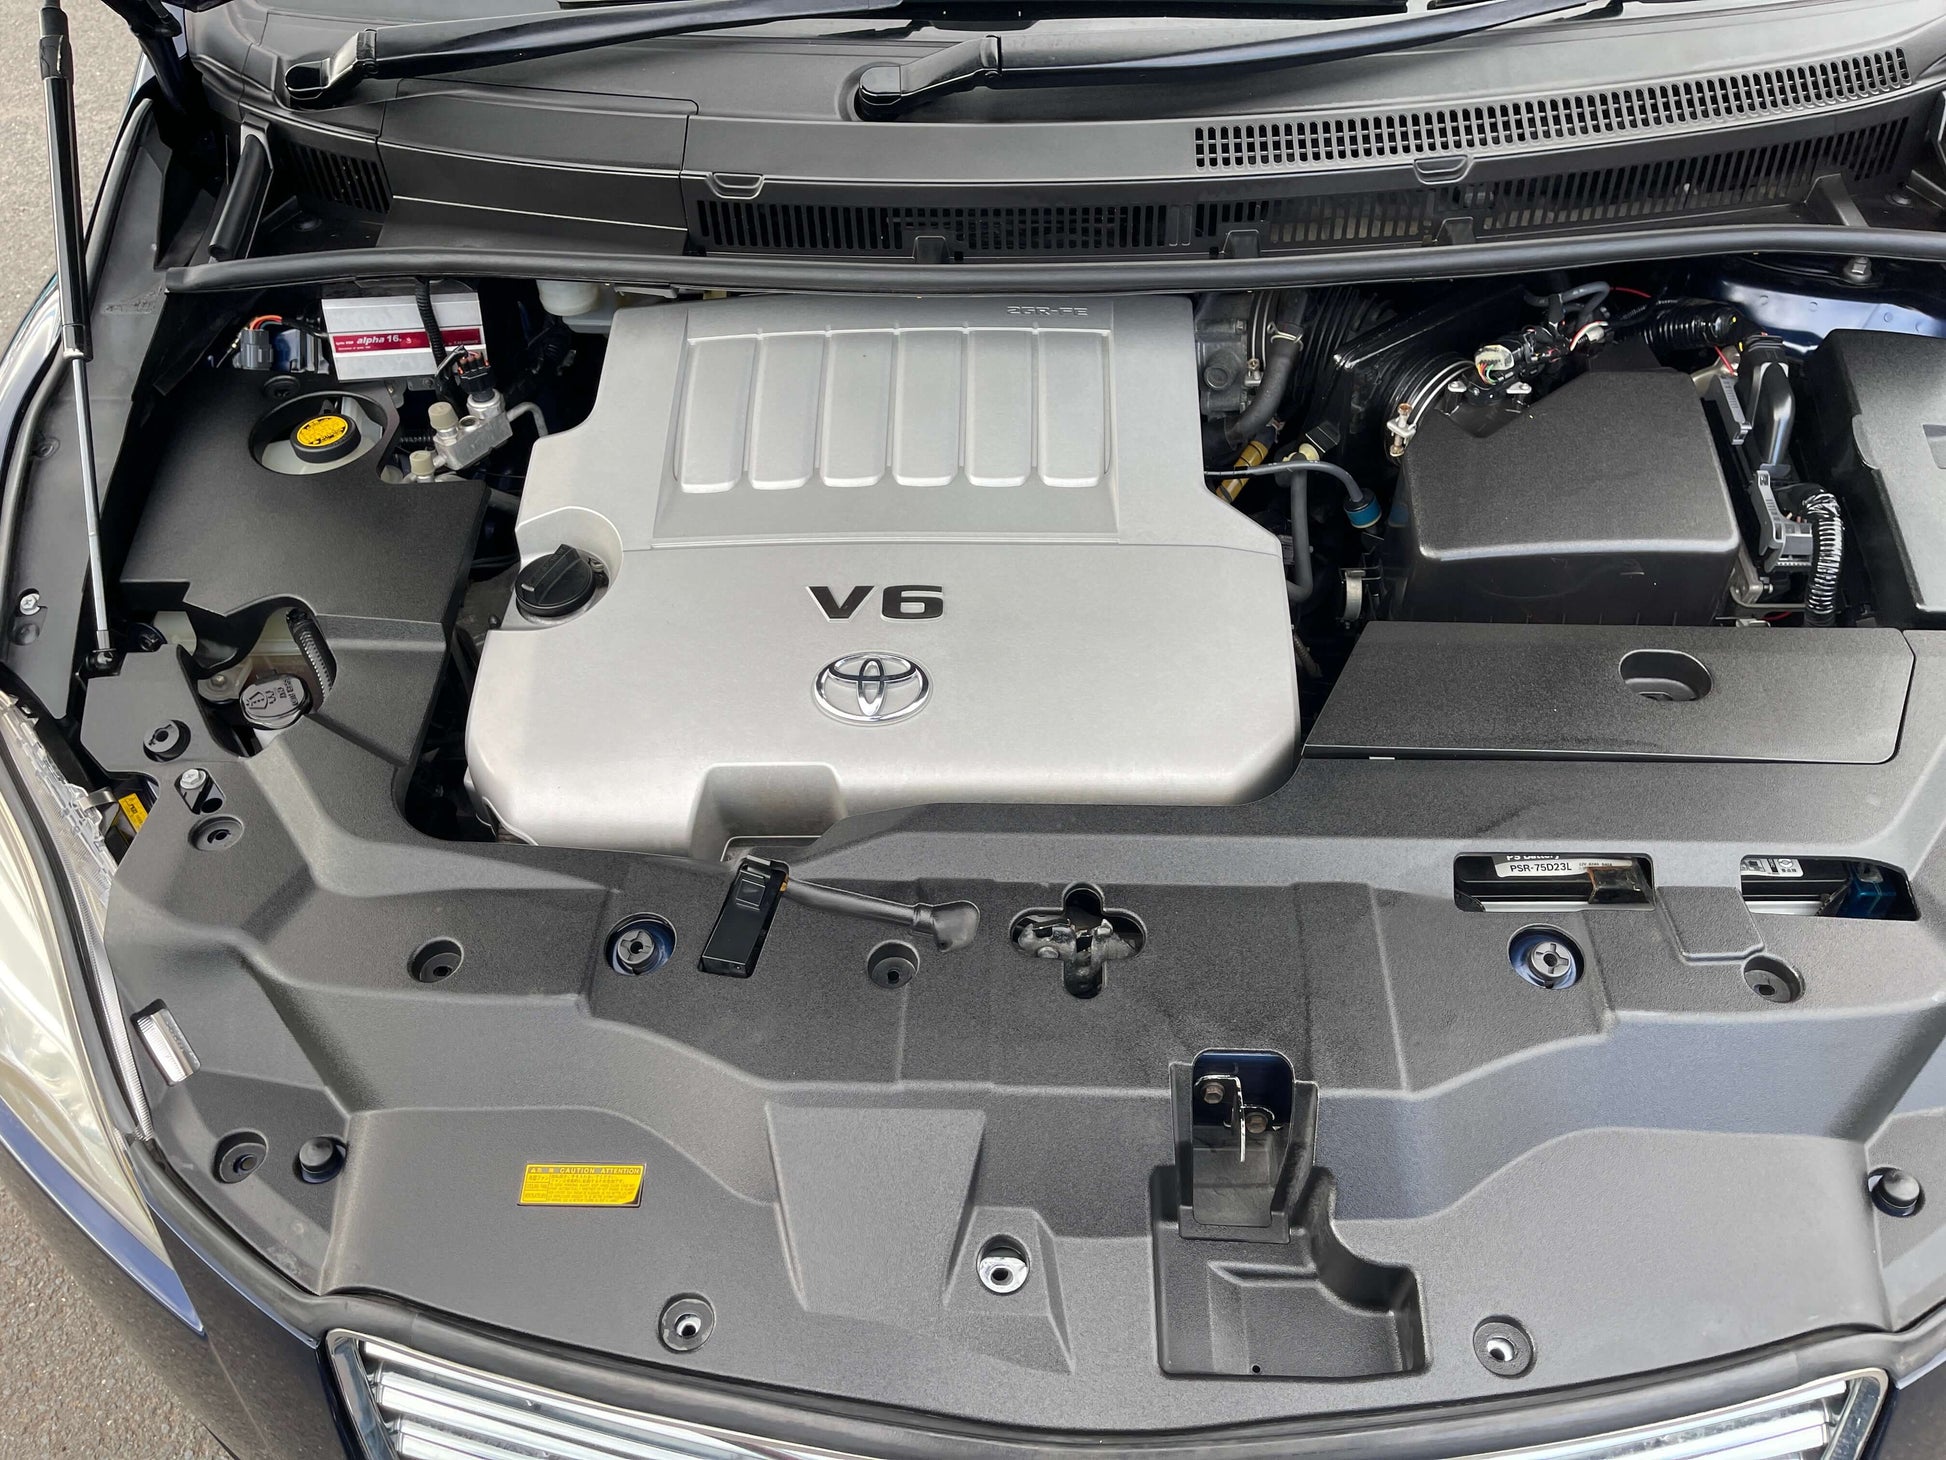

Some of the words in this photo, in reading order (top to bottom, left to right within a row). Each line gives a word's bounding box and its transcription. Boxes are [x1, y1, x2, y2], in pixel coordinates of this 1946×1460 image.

[1007, 306, 1088, 316] 2GR-FE
[356, 336, 385, 346] alpha
[807, 585, 944, 621] V6
[1510, 862, 1572, 872] PSR-75D23L
